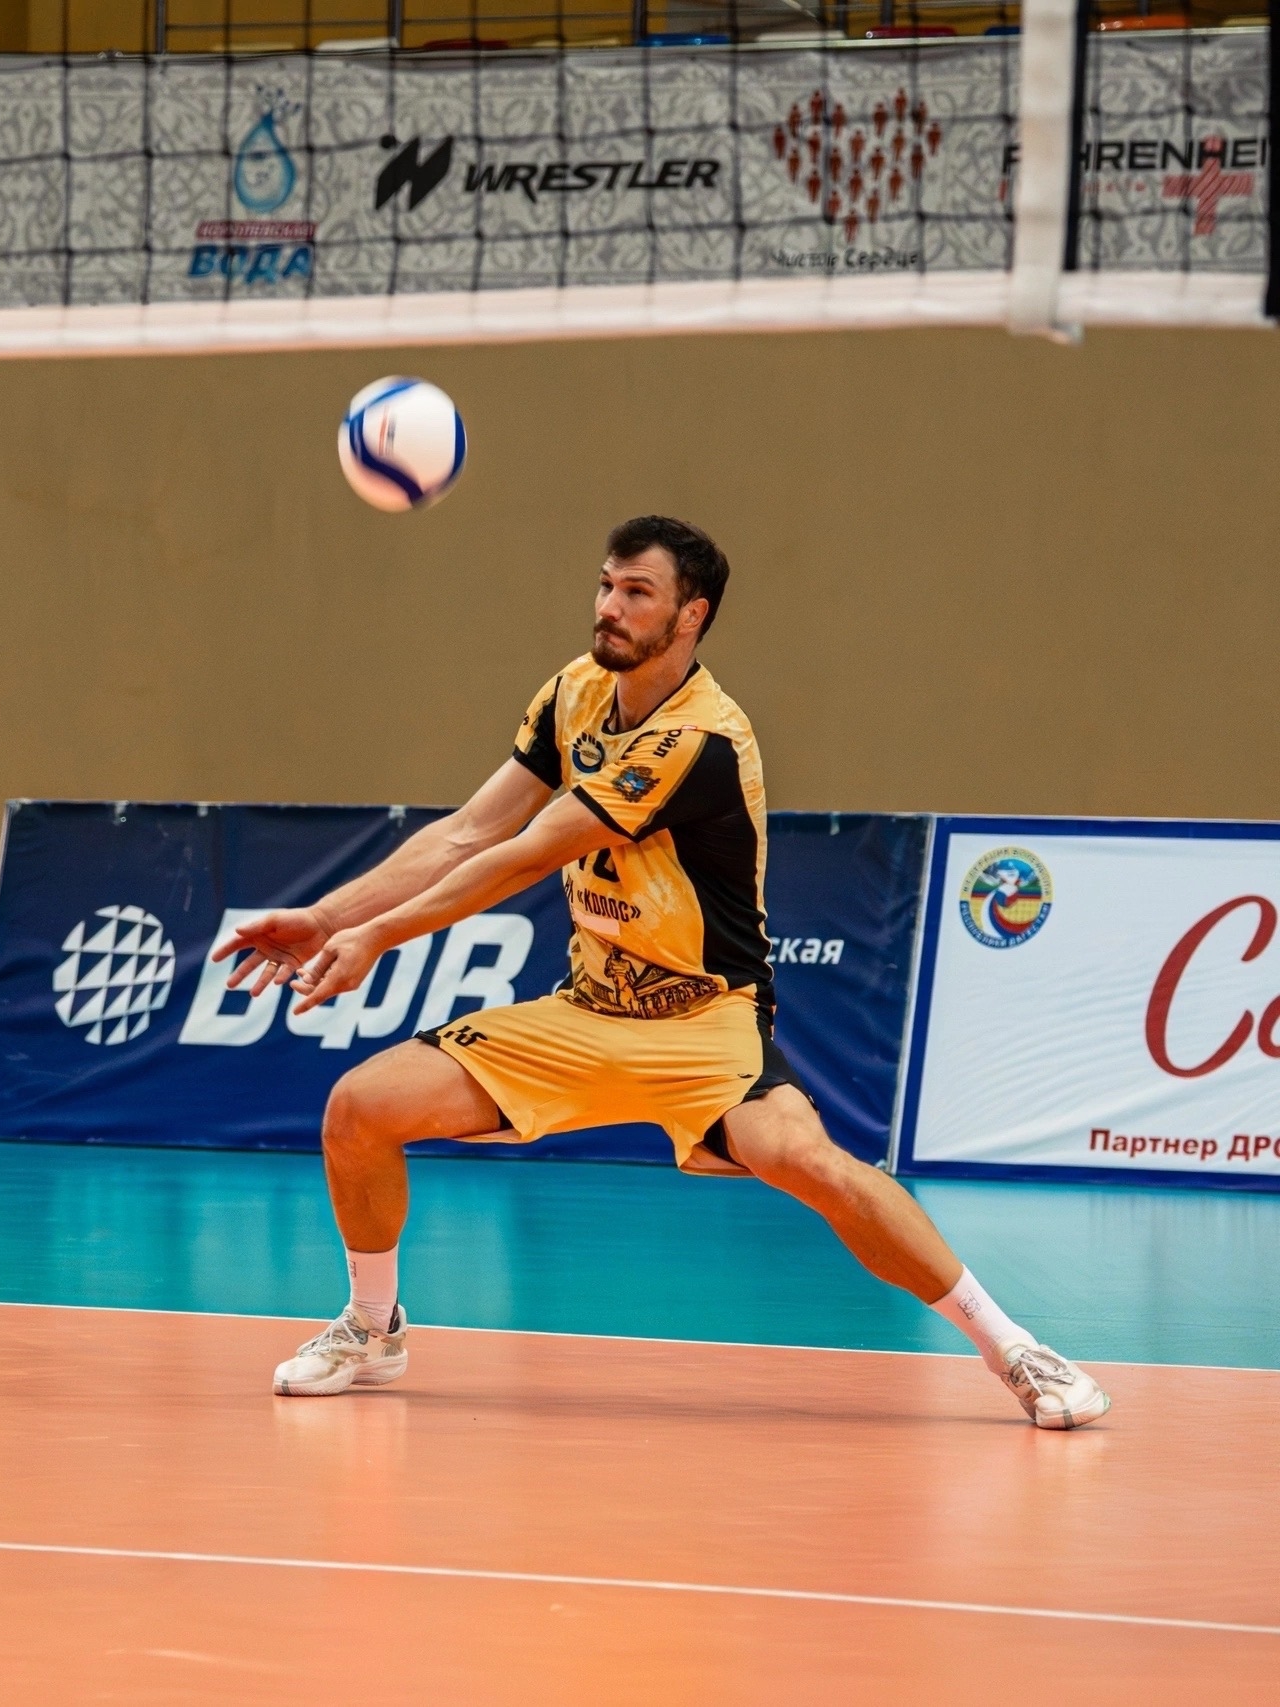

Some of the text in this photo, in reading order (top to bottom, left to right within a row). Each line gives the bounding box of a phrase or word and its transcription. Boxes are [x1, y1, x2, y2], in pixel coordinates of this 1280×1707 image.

[464, 160, 720, 203] WRESTLER
[577, 888, 641, 923] «КОЛОС»
[1090, 1128, 1218, 1161] Партнер
